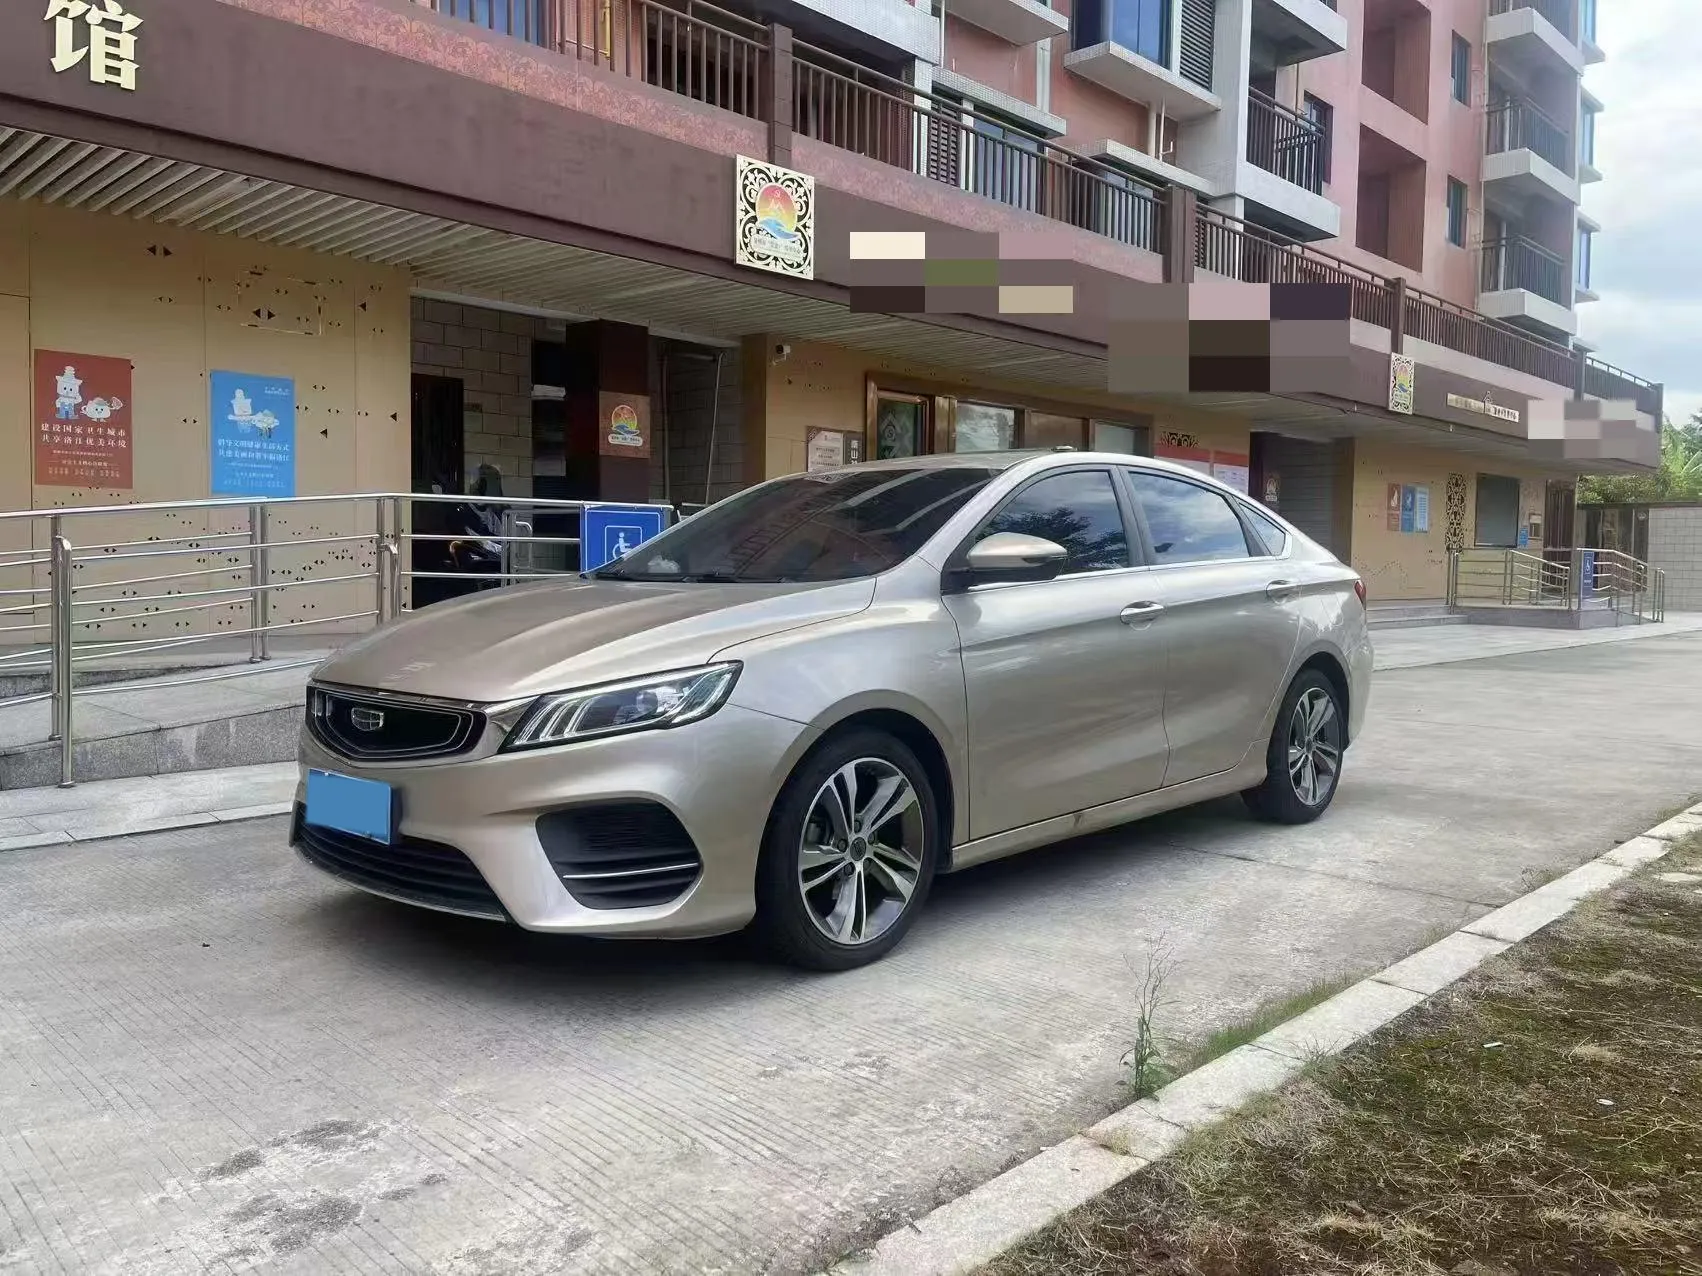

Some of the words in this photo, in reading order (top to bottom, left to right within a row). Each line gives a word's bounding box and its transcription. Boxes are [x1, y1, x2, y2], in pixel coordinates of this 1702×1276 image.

[43, 0, 144, 91] 馆
[41, 422, 126, 437] 建设国家卫生城市
[42, 434, 127, 448] 共享洛江优美环境
